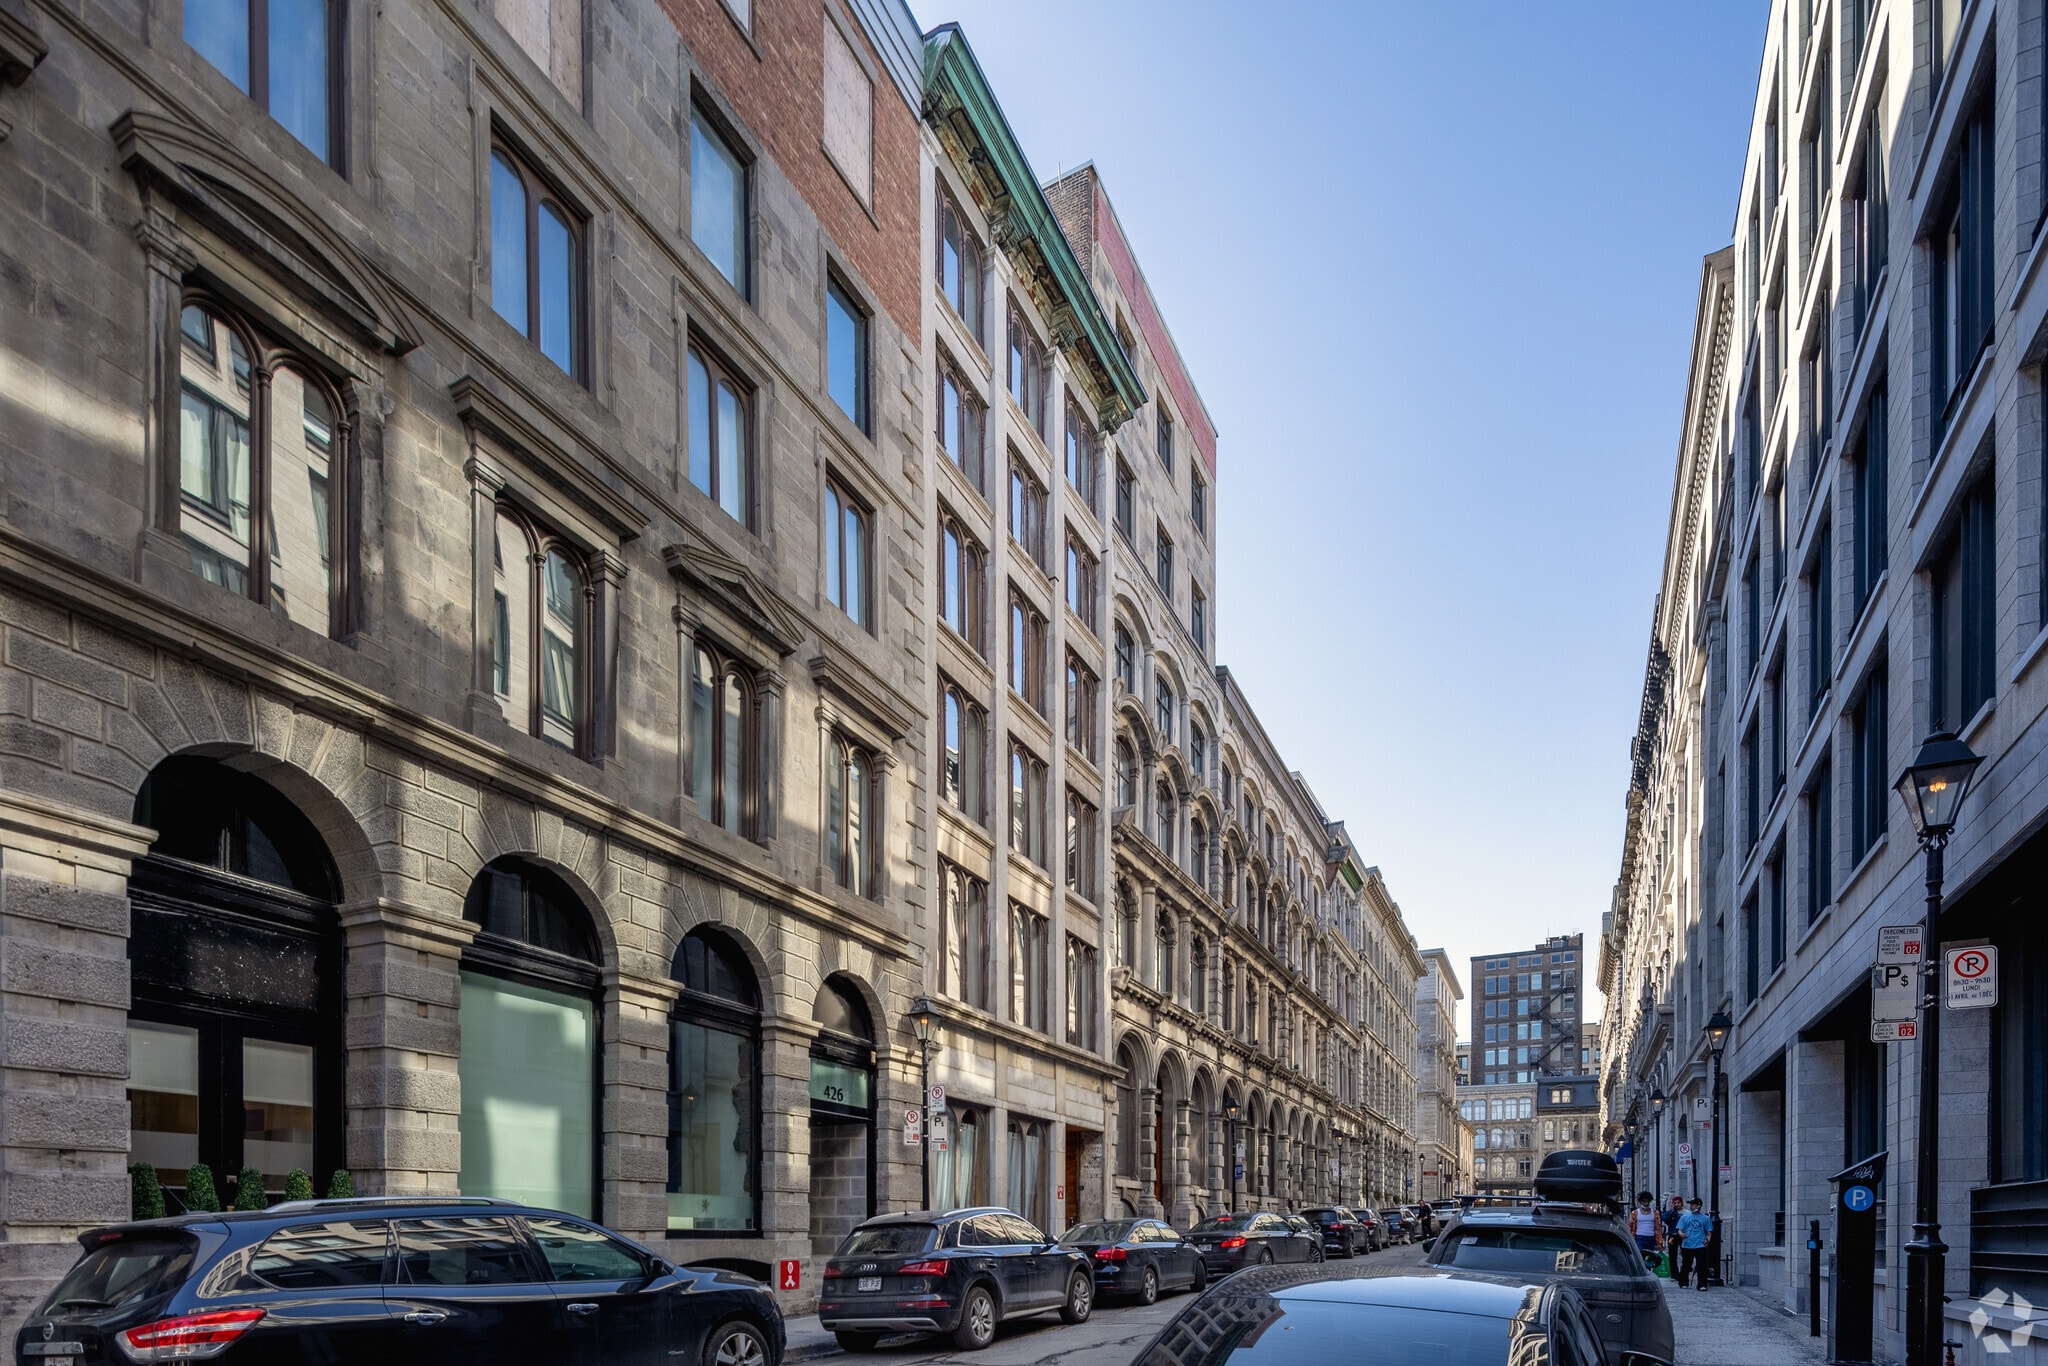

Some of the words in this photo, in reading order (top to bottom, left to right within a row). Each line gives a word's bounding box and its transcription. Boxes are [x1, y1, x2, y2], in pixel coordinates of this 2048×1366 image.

[1906, 945, 1918, 954] 02
[1901, 1028, 1913, 1036] 02
[823, 1085, 844, 1102] 426
